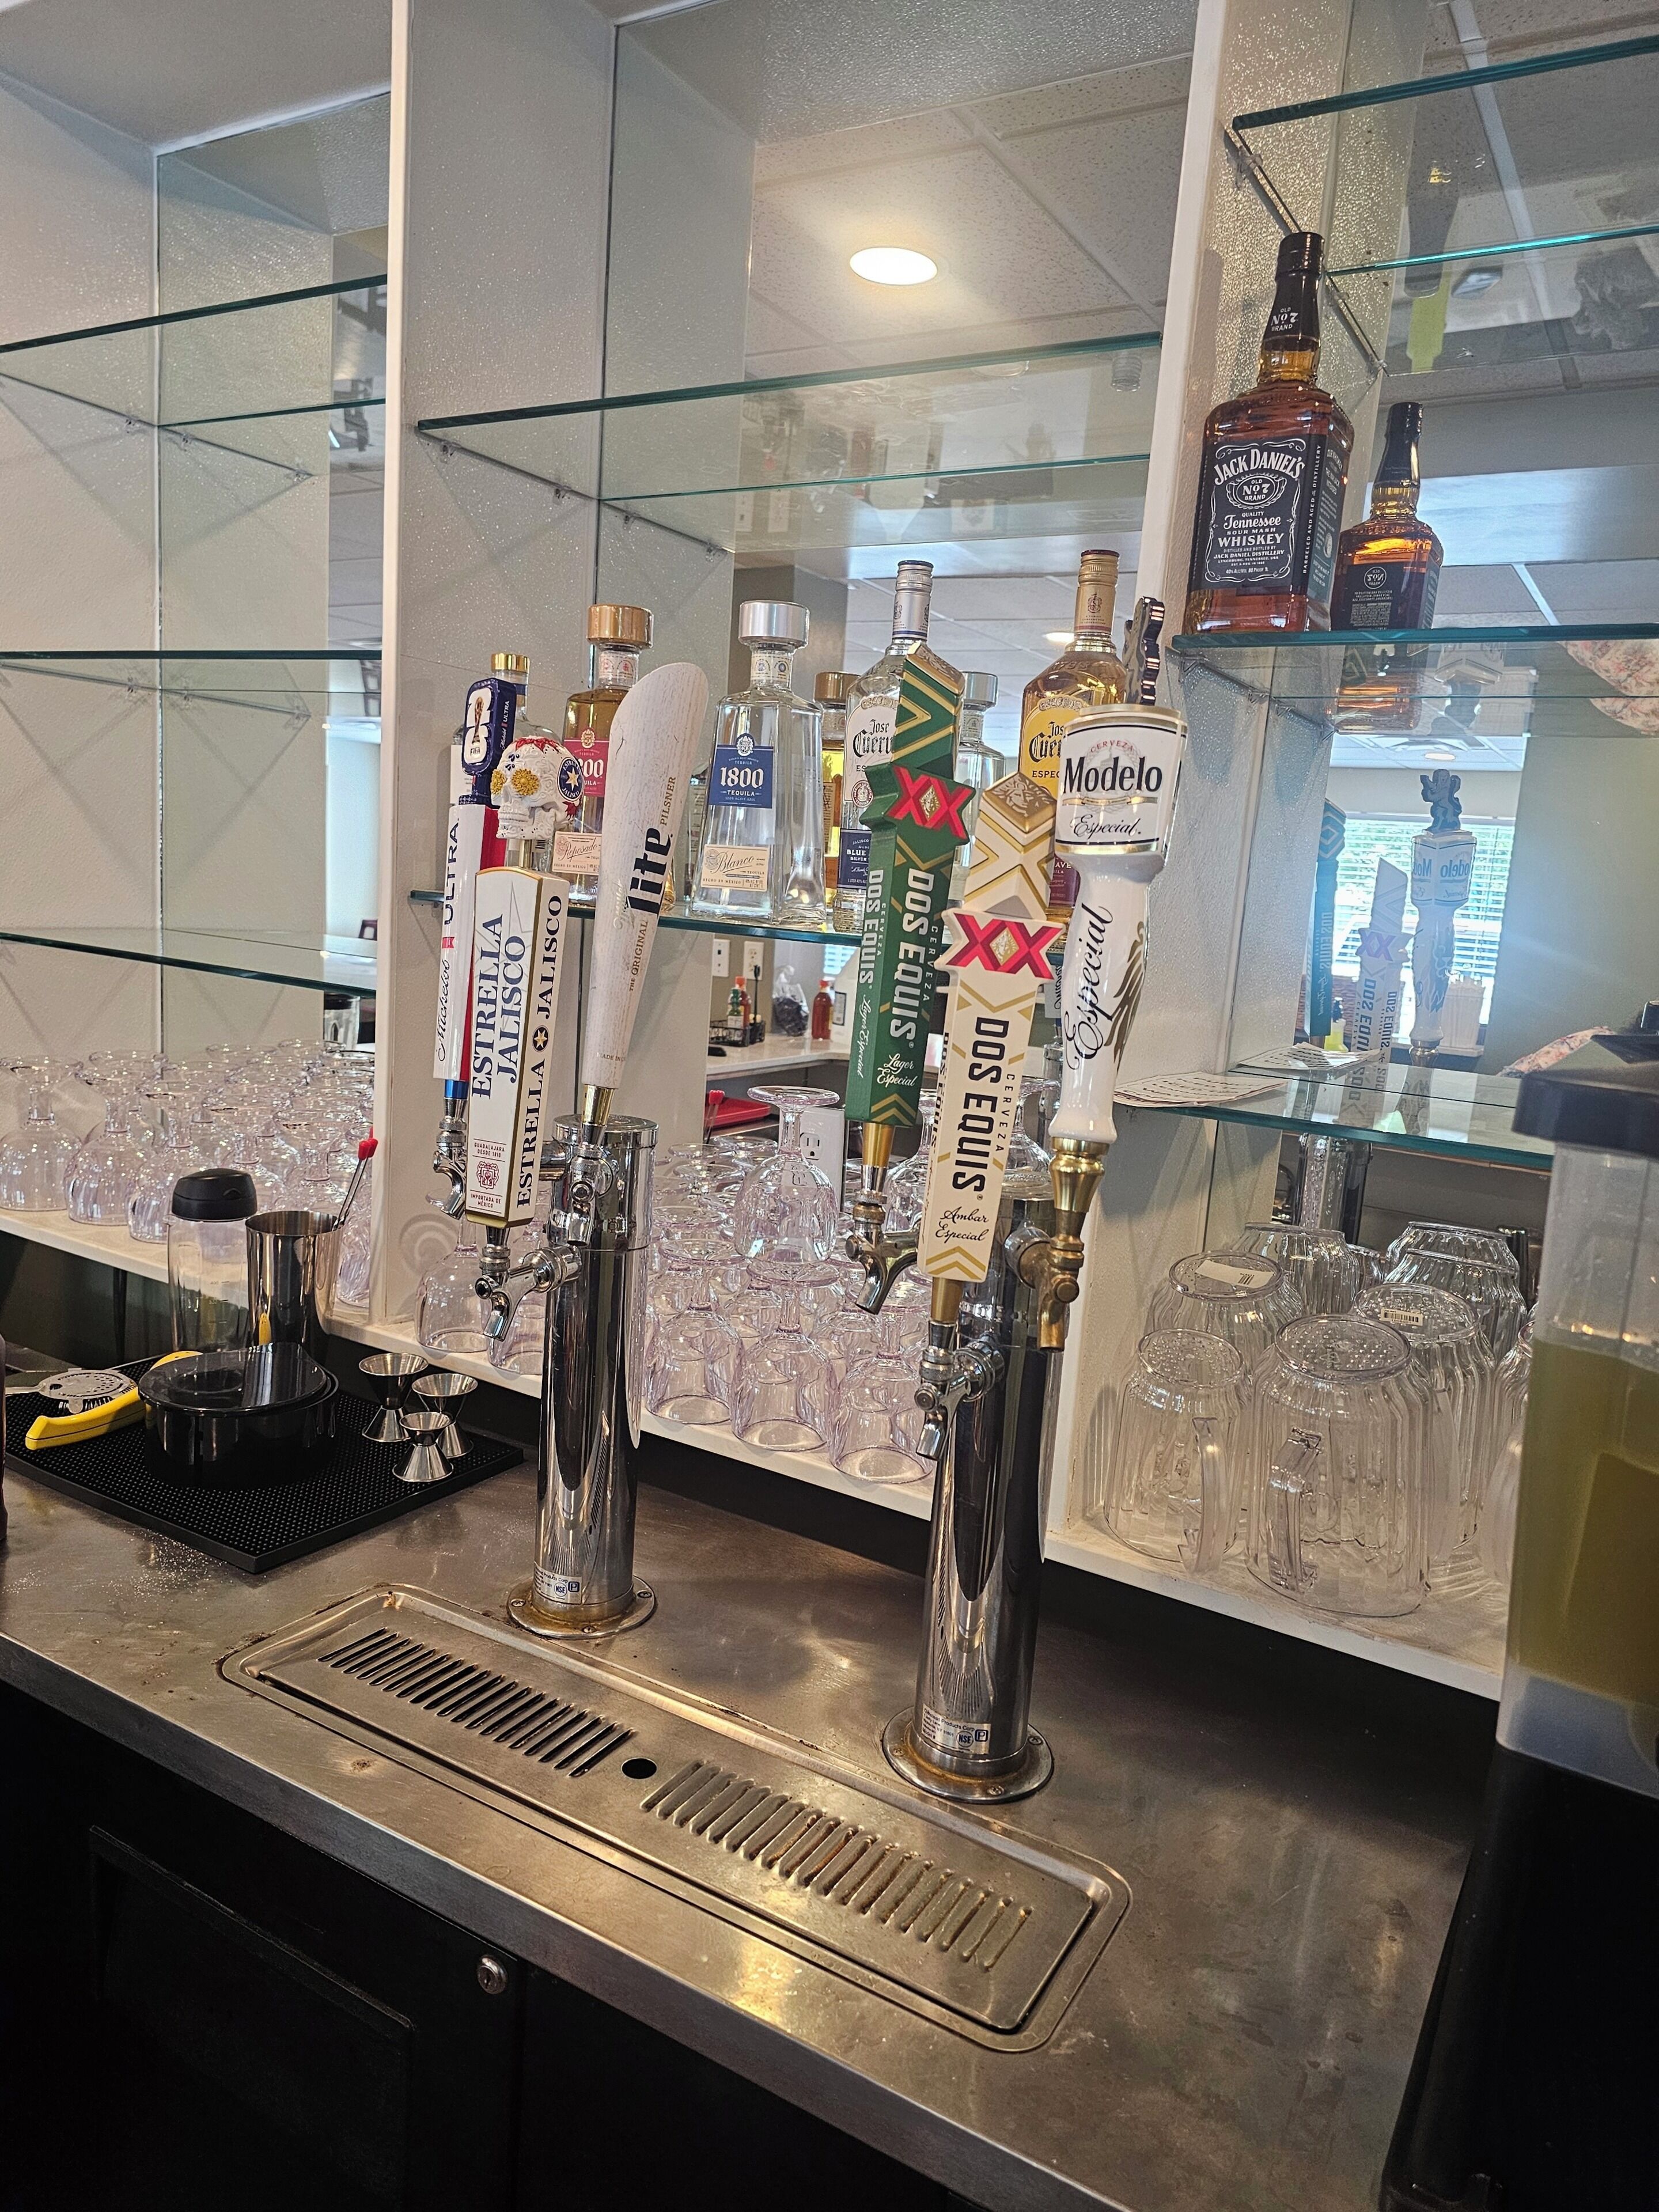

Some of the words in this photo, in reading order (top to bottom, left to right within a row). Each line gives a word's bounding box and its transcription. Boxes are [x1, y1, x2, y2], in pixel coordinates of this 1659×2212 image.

[1271, 324, 1293, 332] BRAND
[1290, 312, 1298, 323] 7
[1214, 455, 1249, 485] JACK
[1250, 449, 1305, 479] DANIEL'S
[1262, 484, 1271, 494] 7
[1224, 514, 1282, 530] Tennessee
[1302, 535, 1311, 574] BARRELED
[1313, 445, 1322, 488] DISTILLERY
[1218, 533, 1285, 547] WHISKEY
[853, 729, 894, 758] Cuerv
[869, 719, 889, 735] Jose
[1048, 721, 1064, 738] Jos
[1029, 732, 1061, 763] Cuer
[1090, 739, 1134, 753] CERVEZA
[720, 767, 764, 788] 1800
[1032, 770, 1060, 778] ESPEC
[1063, 756, 1162, 794] Modelo
[660, 777, 676, 826] PILSNER
[558, 838, 597, 862] Reposado
[710, 851, 754, 874] Blanco
[626, 828, 671, 915] lite
[866, 870, 883, 913] DOS
[902, 868, 935, 935] DOS
[436, 959, 450, 1062] Michelob
[444, 823, 459, 925] ULTRA
[877, 903, 886, 956] CERVEZA
[631, 921, 648, 975] ORIGINAL
[859, 918, 878, 985] EQUIS
[923, 925, 939, 1002] CERVEZA
[890, 941, 926, 1041] EQUIS
[1065, 902, 1113, 1070] Especial
[472, 914, 503, 1099] ESTRELLA
[497, 935, 525, 1084] JALISCO
[861, 994, 872, 1031] Lager
[517, 1058, 545, 1208] ESTRELLA
[537, 896, 562, 1019] JALISCO
[856, 1030, 870, 1079] Especial
[884, 1053, 914, 1074] Lager
[968, 1017, 1009, 1084] DOS
[877, 1067, 918, 1087] Especial
[995, 1074, 1015, 1152] CERVEZA
[474, 1142, 505, 1152] GUADALAJARA
[952, 1092, 998, 1195] EQUIS
[471, 1194, 494, 1202] IMPORTADA
[944, 1206, 989, 1225] Ambar
[935, 1221, 989, 1244] Especial
[941, 1718, 961, 1729] Products
